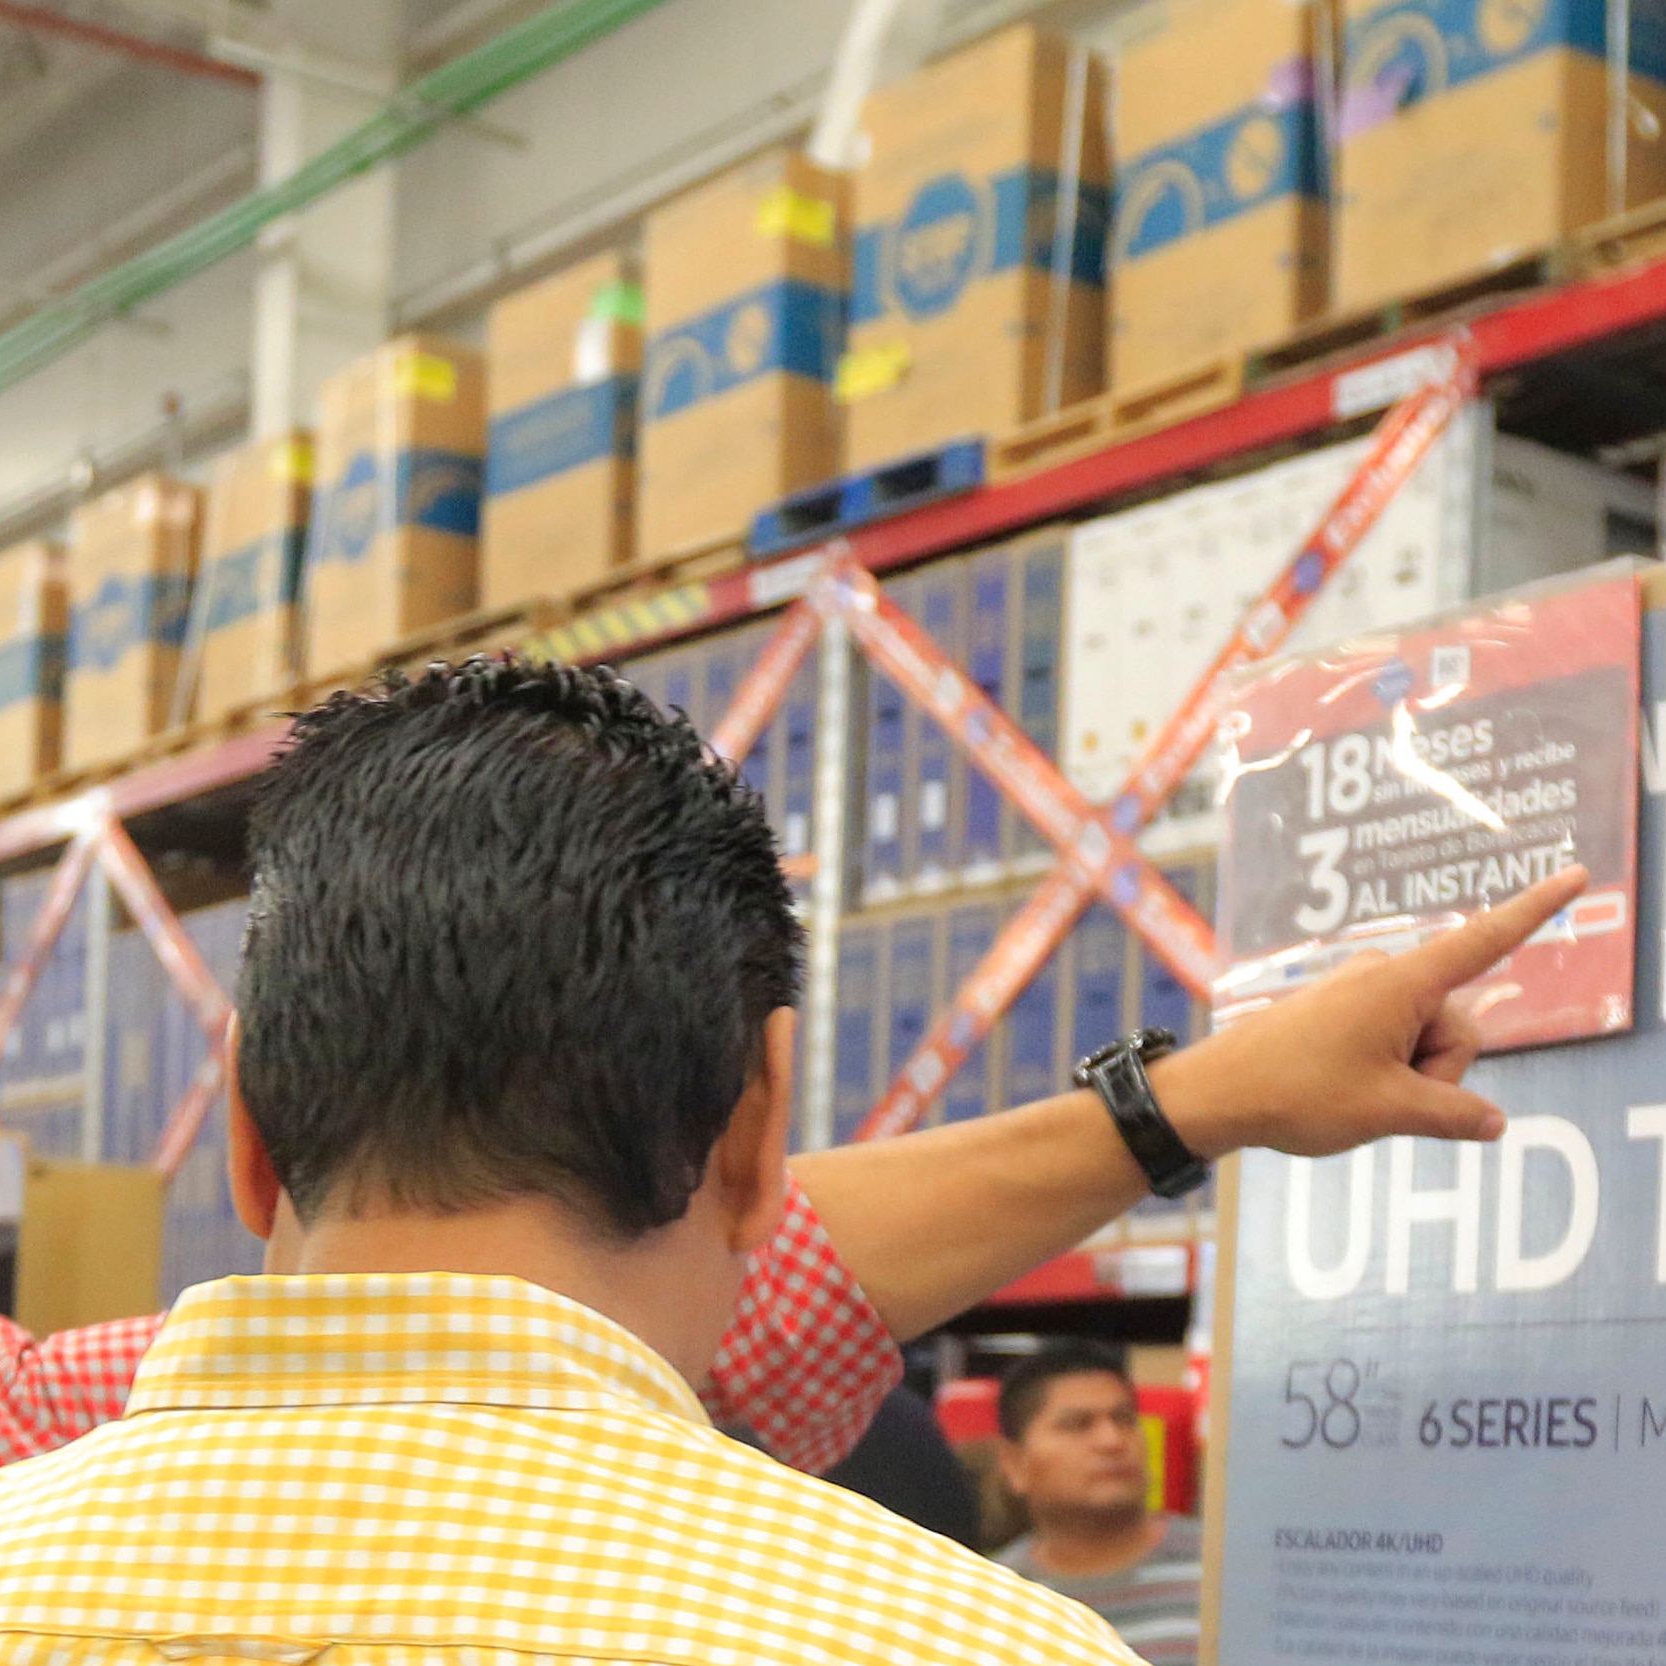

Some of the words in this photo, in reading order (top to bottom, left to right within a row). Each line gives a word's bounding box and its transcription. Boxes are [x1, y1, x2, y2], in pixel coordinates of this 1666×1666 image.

[1299, 732, 1373, 822] 18
[1515, 741, 1576, 770] recibe
[1294, 826, 1351, 933] 3
[1353, 878, 1399, 919] AL
[1403, 845, 1576, 908] INSTANTE
[1286, 1112, 1599, 1300] UHD
[1418, 1404, 1443, 1449] 6
[1449, 1396, 1598, 1450] SERIES
[1274, 1527, 1372, 1551] ESCALADOR
